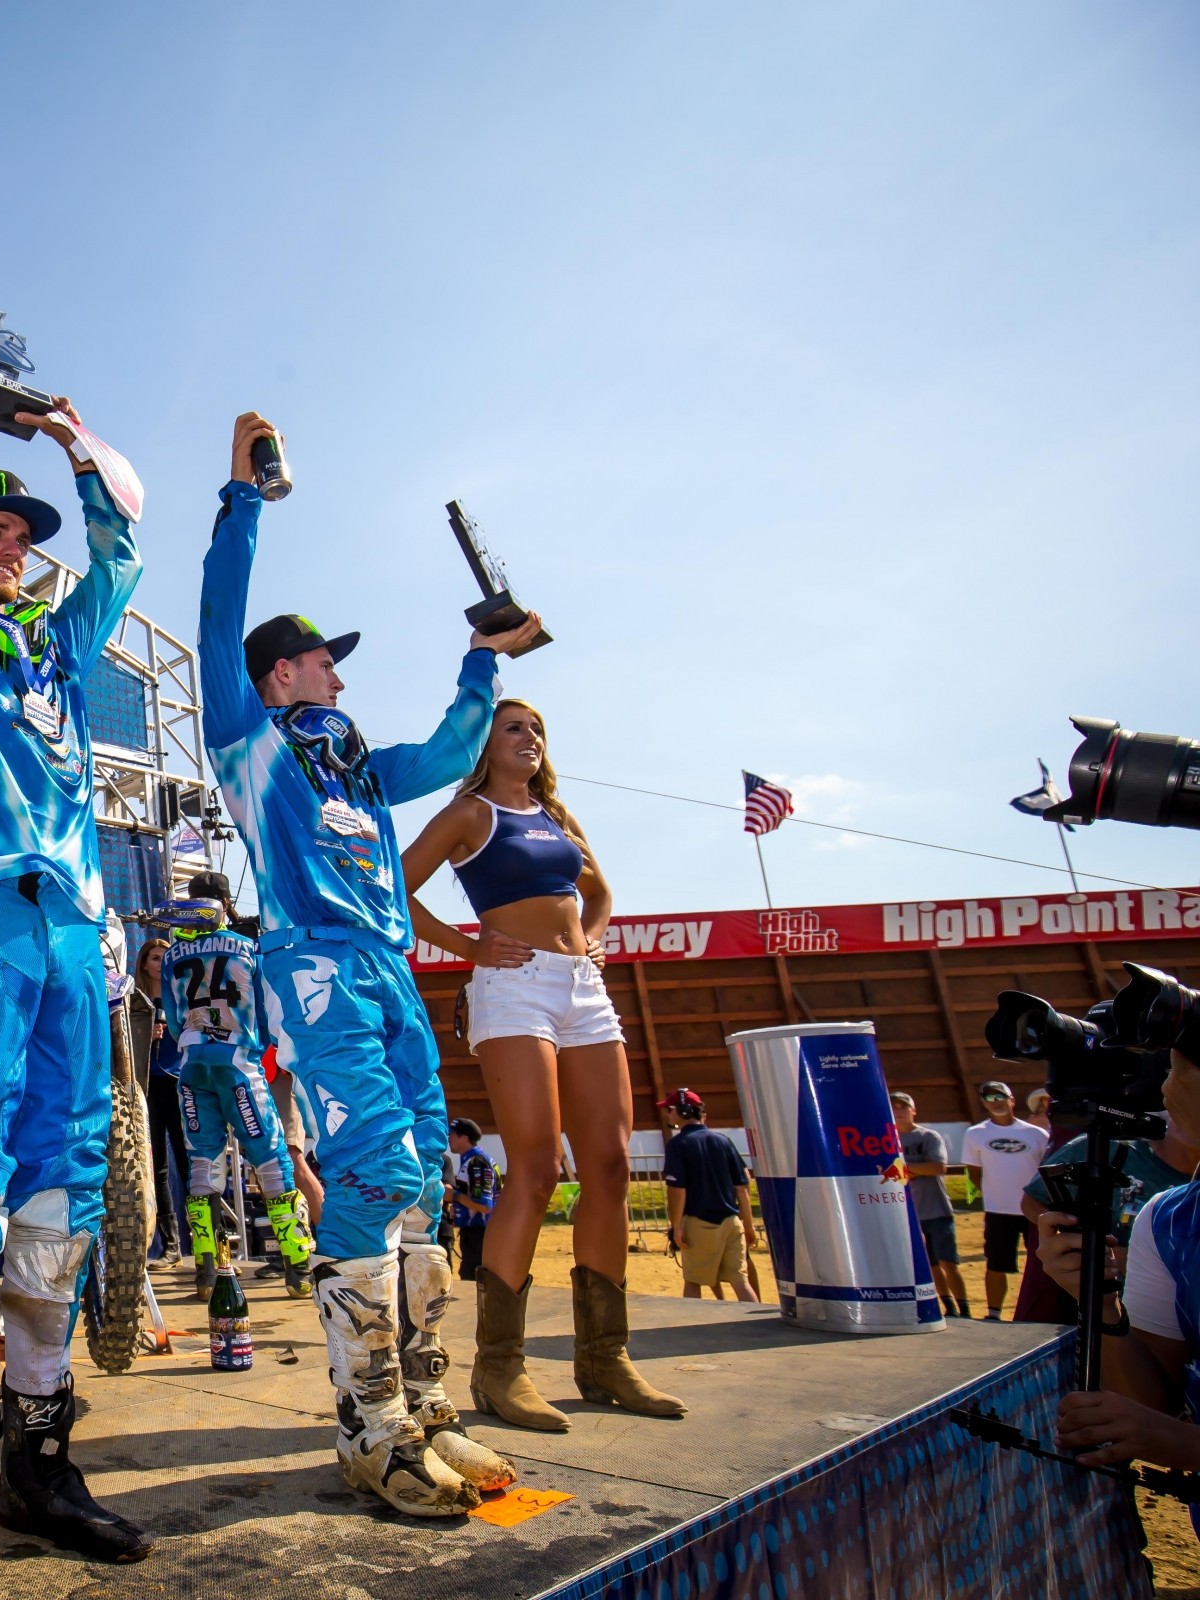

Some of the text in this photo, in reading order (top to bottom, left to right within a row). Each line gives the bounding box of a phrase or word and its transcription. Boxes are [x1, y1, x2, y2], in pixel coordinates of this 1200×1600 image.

[326, 718, 349, 736] 100%
[758, 909, 820, 936] High
[882, 900, 996, 948] High
[1001, 893, 1136, 937] Point
[164, 936, 254, 966] FERRANDIS
[603, 920, 713, 959] eway
[766, 928, 839, 954] Point
[173, 955, 242, 1011] 24
[237, 1096, 261, 1138] YAMAHA
[837, 1125, 897, 1158] Red
[859, 1288, 884, 1300] With
